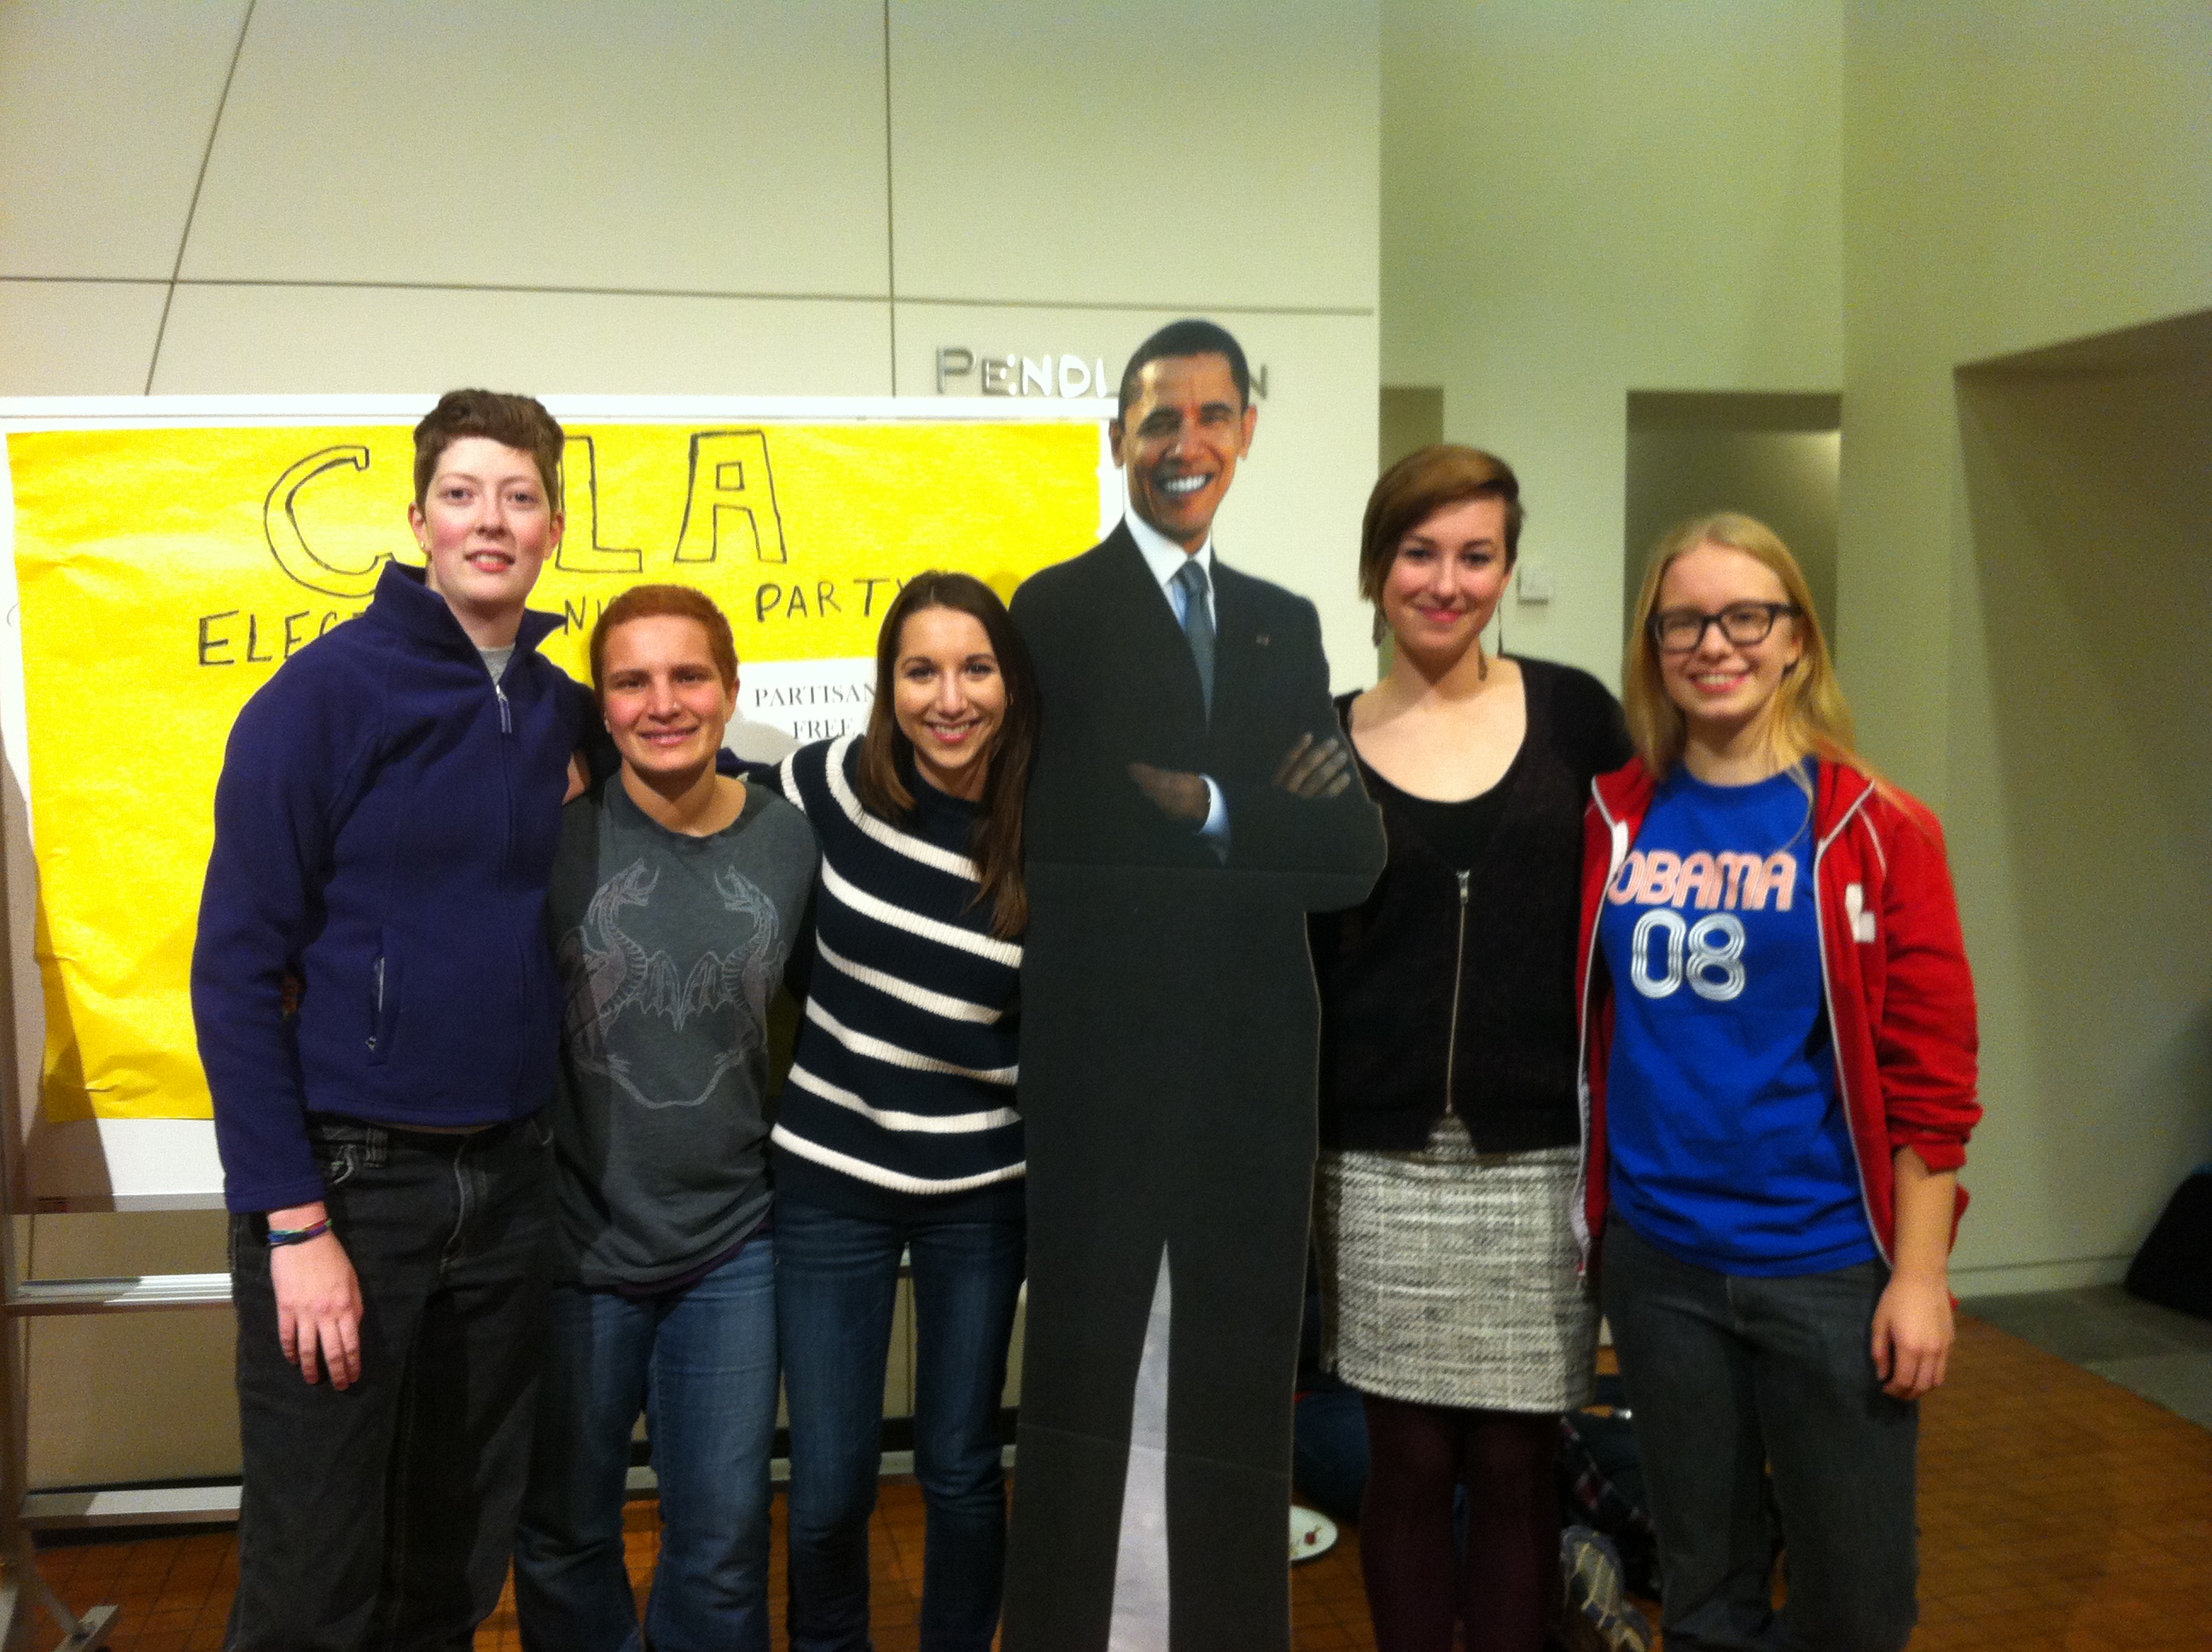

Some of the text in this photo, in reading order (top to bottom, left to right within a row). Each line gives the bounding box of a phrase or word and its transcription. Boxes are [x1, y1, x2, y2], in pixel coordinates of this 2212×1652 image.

[936, 346, 1268, 399] PENDLN
[755, 578, 904, 622] PART
[754, 683, 876, 707] PARTISAN
[793, 718, 856, 740] FREE
[1607, 850, 1797, 911] OBAMA
[1631, 908, 1746, 1002] 08
